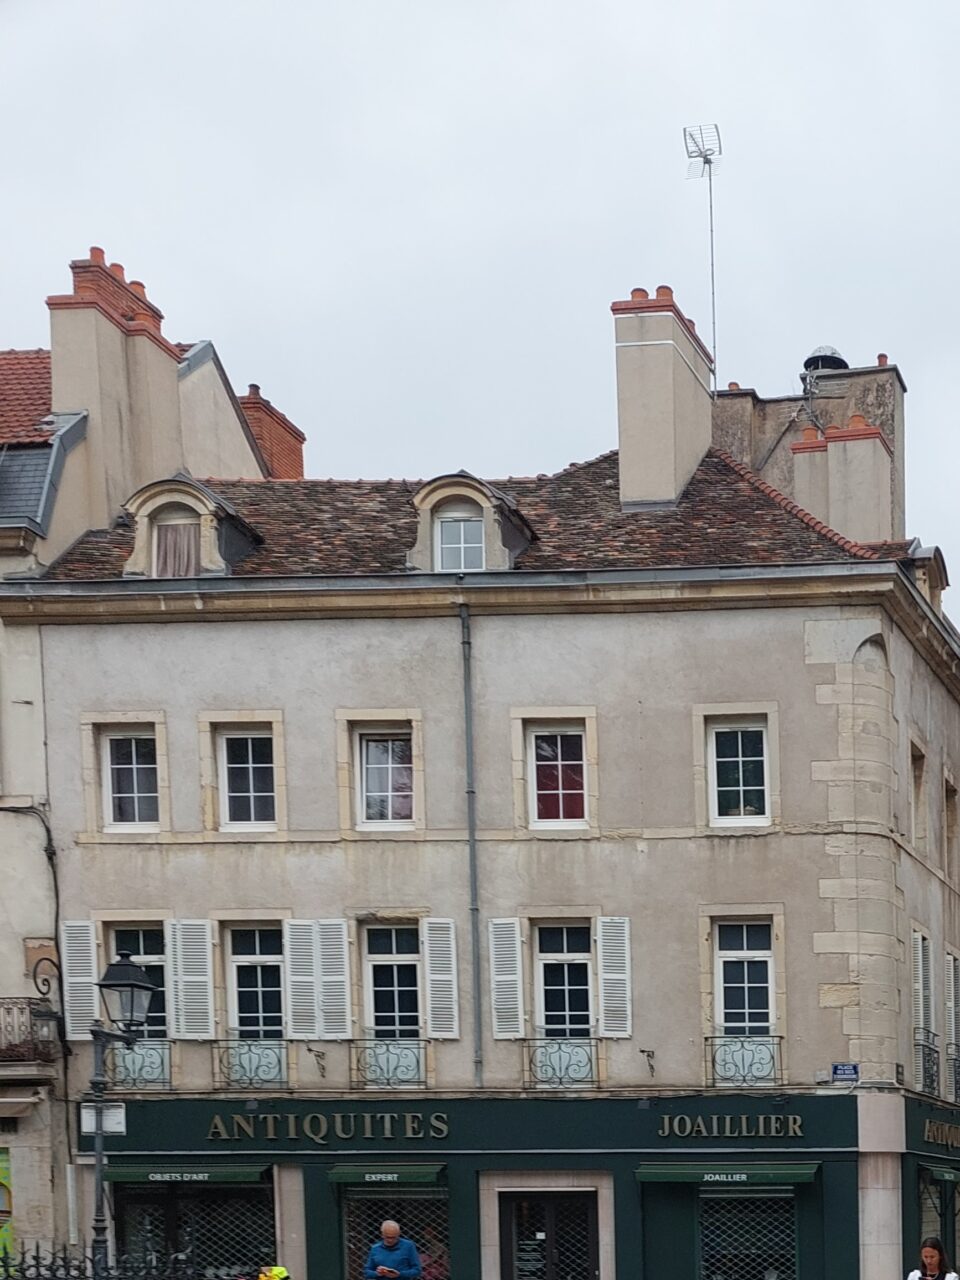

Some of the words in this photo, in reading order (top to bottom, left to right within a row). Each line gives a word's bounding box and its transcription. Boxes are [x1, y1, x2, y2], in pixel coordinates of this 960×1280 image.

[206, 1113, 449, 1144] ANTIQUITES
[658, 1114, 804, 1137] JOAILLIER
[148, 1173, 182, 1181] OBJETS
[182, 1173, 210, 1181] D'ART
[703, 1173, 748, 1181] JOAILLIER
